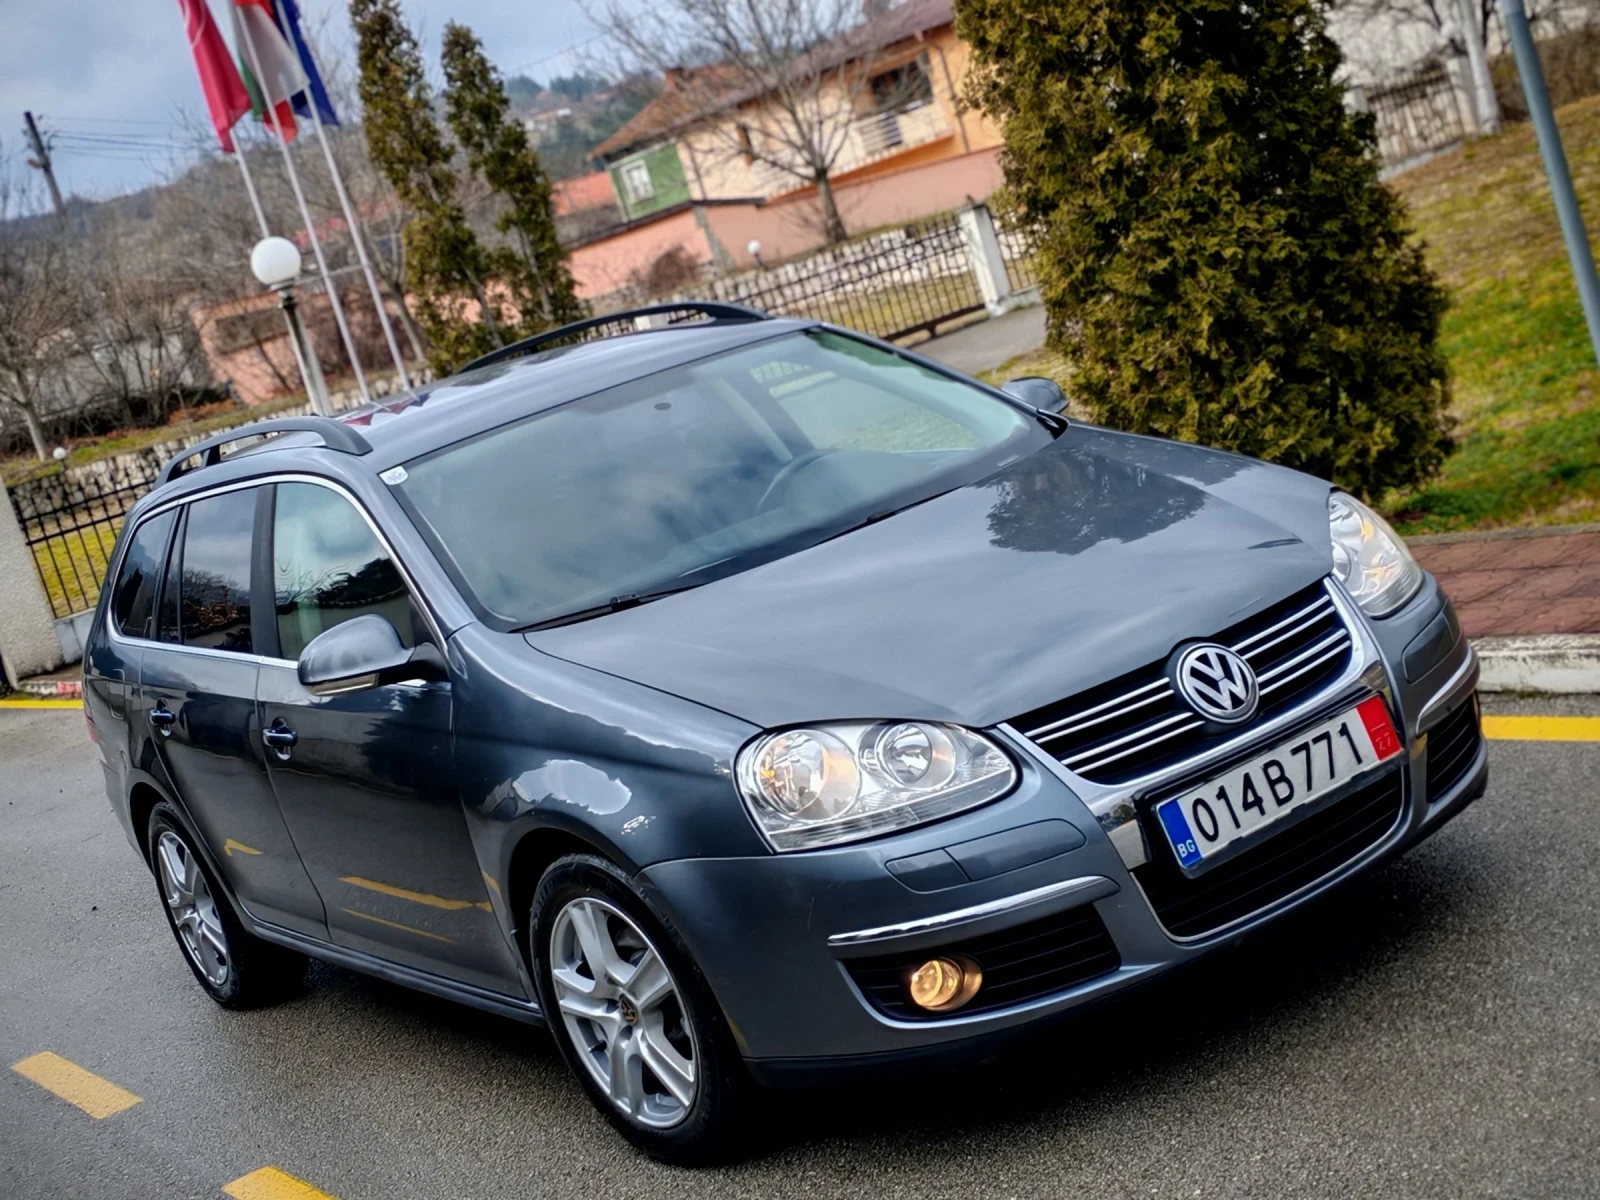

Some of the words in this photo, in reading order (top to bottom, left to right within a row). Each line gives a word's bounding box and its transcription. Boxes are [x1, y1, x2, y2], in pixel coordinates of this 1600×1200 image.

[1184, 646, 1255, 716] VW
[1192, 722, 1363, 842] 014B771
[1177, 839, 1196, 858] BG
